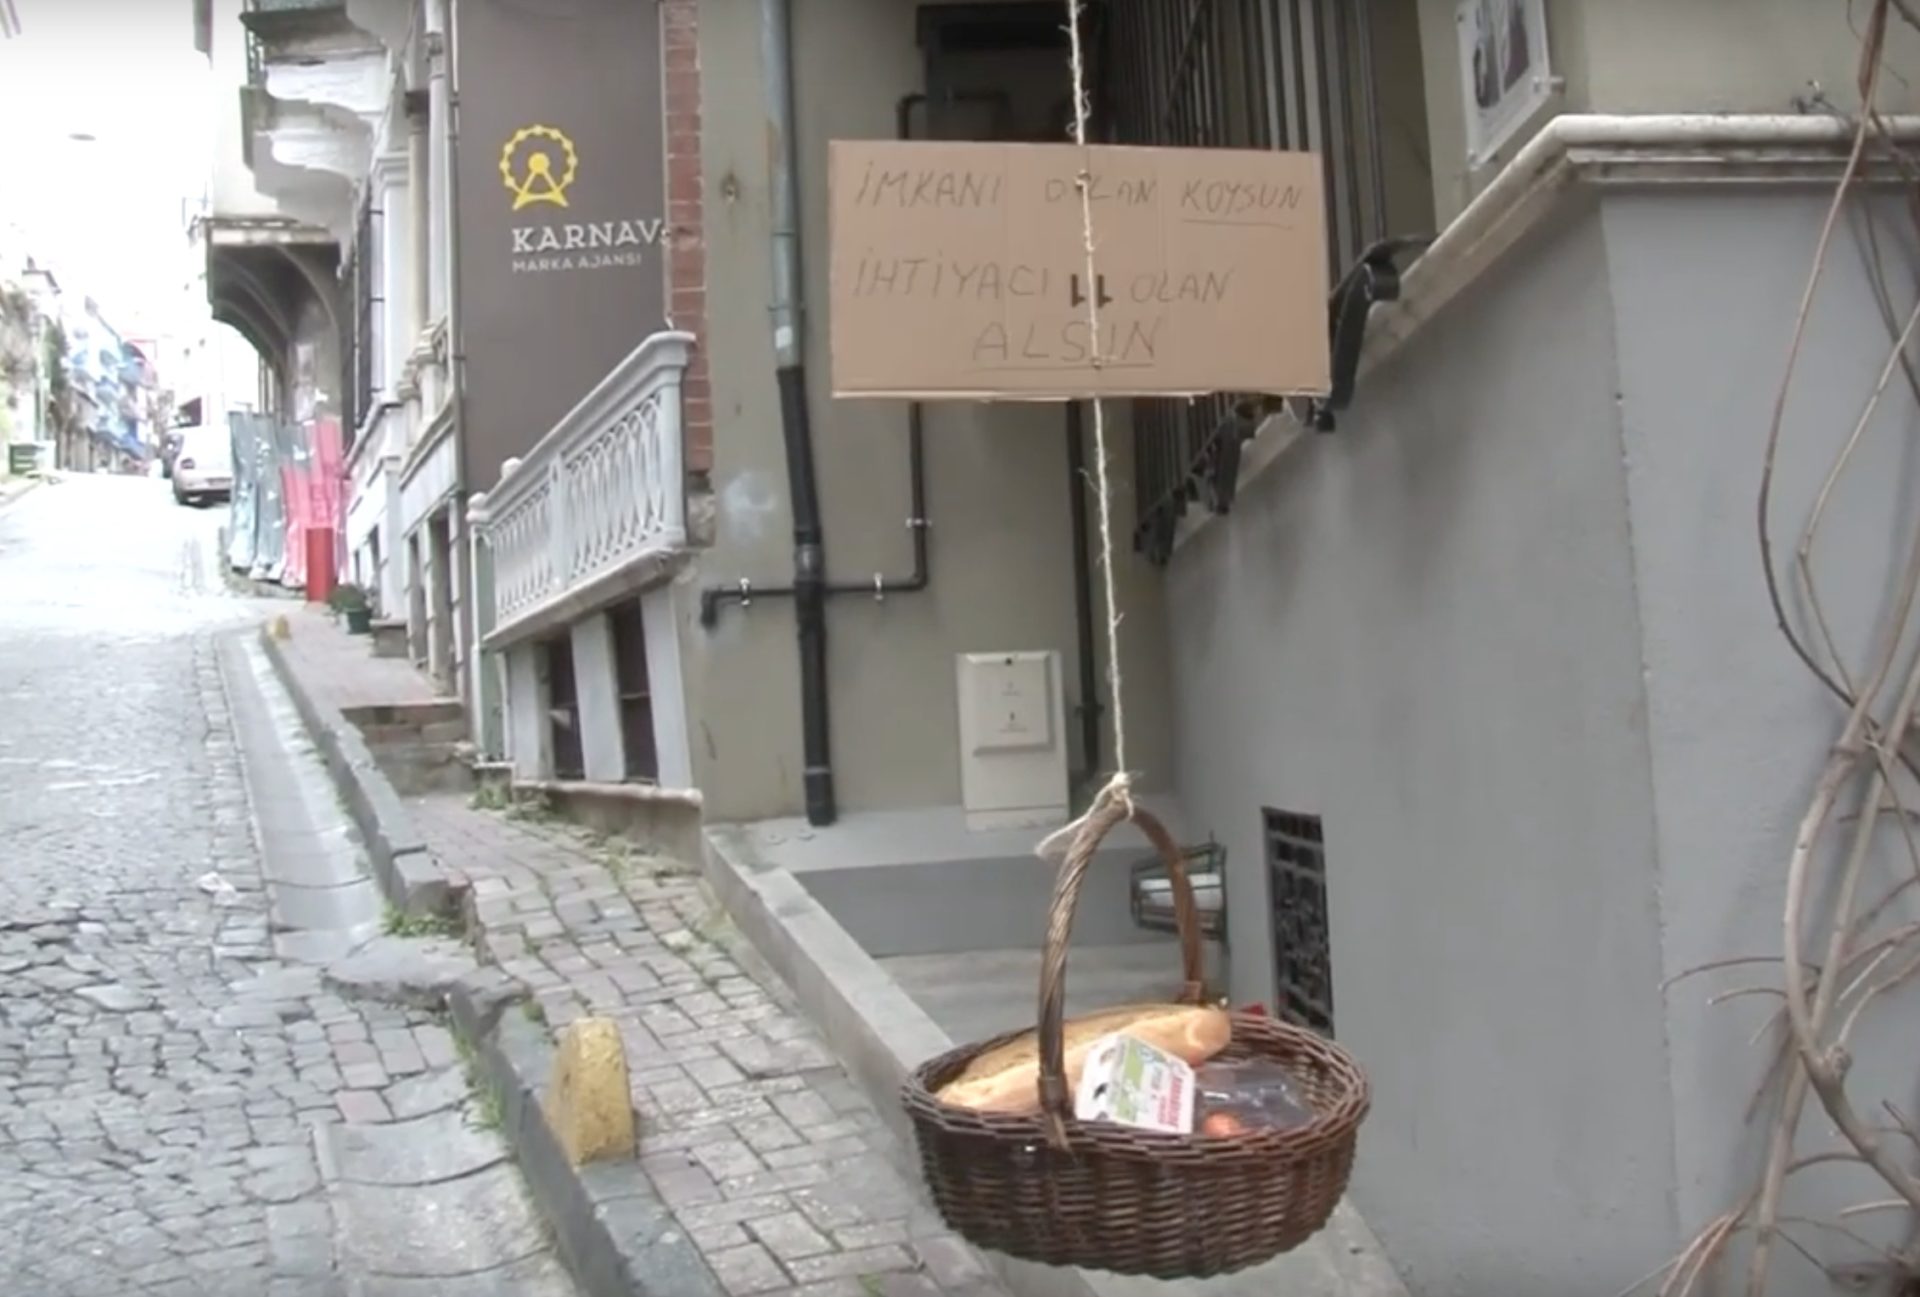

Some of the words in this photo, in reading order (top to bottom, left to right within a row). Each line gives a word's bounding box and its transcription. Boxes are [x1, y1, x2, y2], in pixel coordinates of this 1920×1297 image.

[855, 160, 1002, 208] İMKANI
[1180, 178, 1305, 216] KOYSUN
[511, 218, 664, 253] KARNAV
[512, 256, 574, 273] MARKA
[578, 252, 643, 269] AJANSI
[852, 247, 1050, 301] İHTİYACI
[1129, 267, 1235, 304] OLAN
